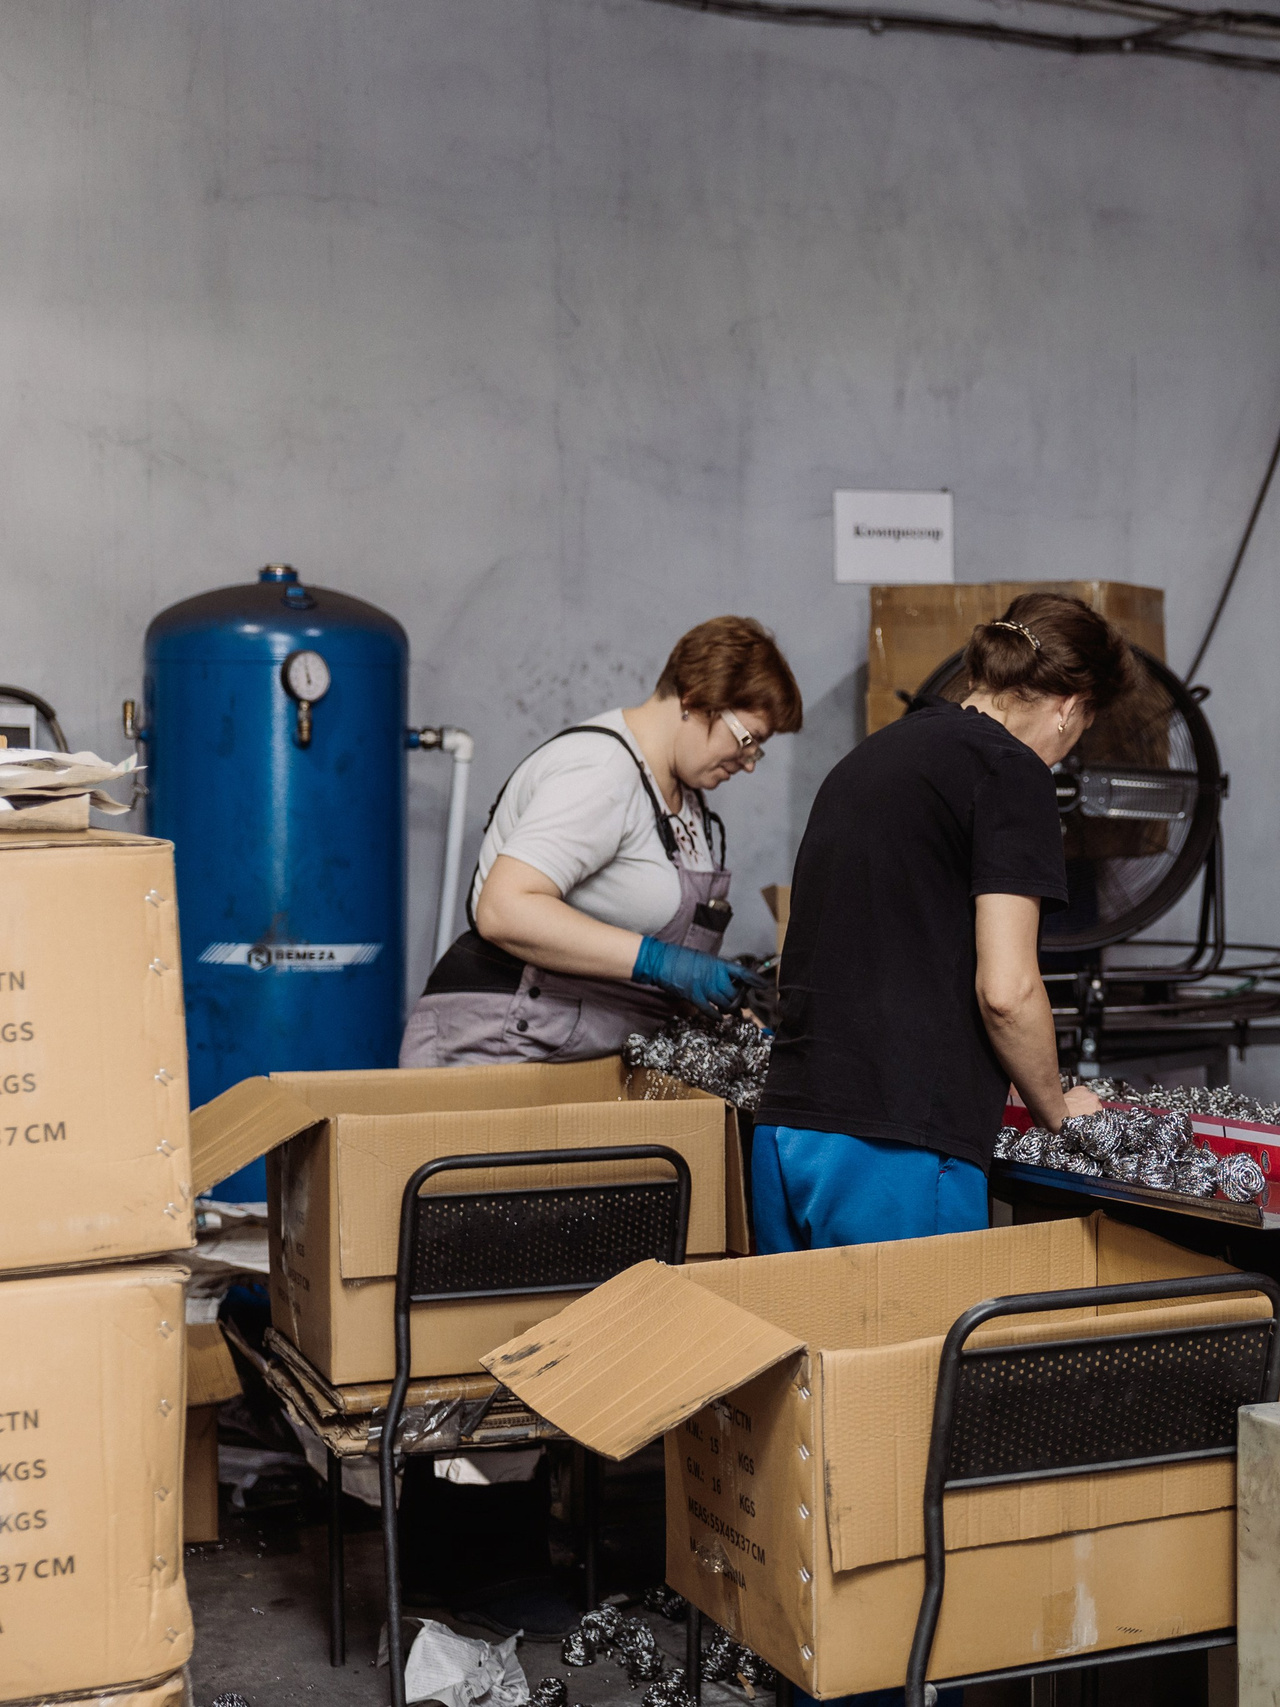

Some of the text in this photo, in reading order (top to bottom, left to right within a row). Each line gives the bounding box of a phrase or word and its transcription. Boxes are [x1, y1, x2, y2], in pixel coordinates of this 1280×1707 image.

[853, 524, 943, 542] Компрессор
[0, 1021, 34, 1043] GS
[0, 1073, 37, 1095] GS
[709, 1436, 720, 1455] 15
[737, 1450, 755, 1476] KGS
[0, 1459, 48, 1483] KGS
[686, 1456, 756, 1518] G.W.: 16 KGS
[0, 1509, 48, 1534] KGS
